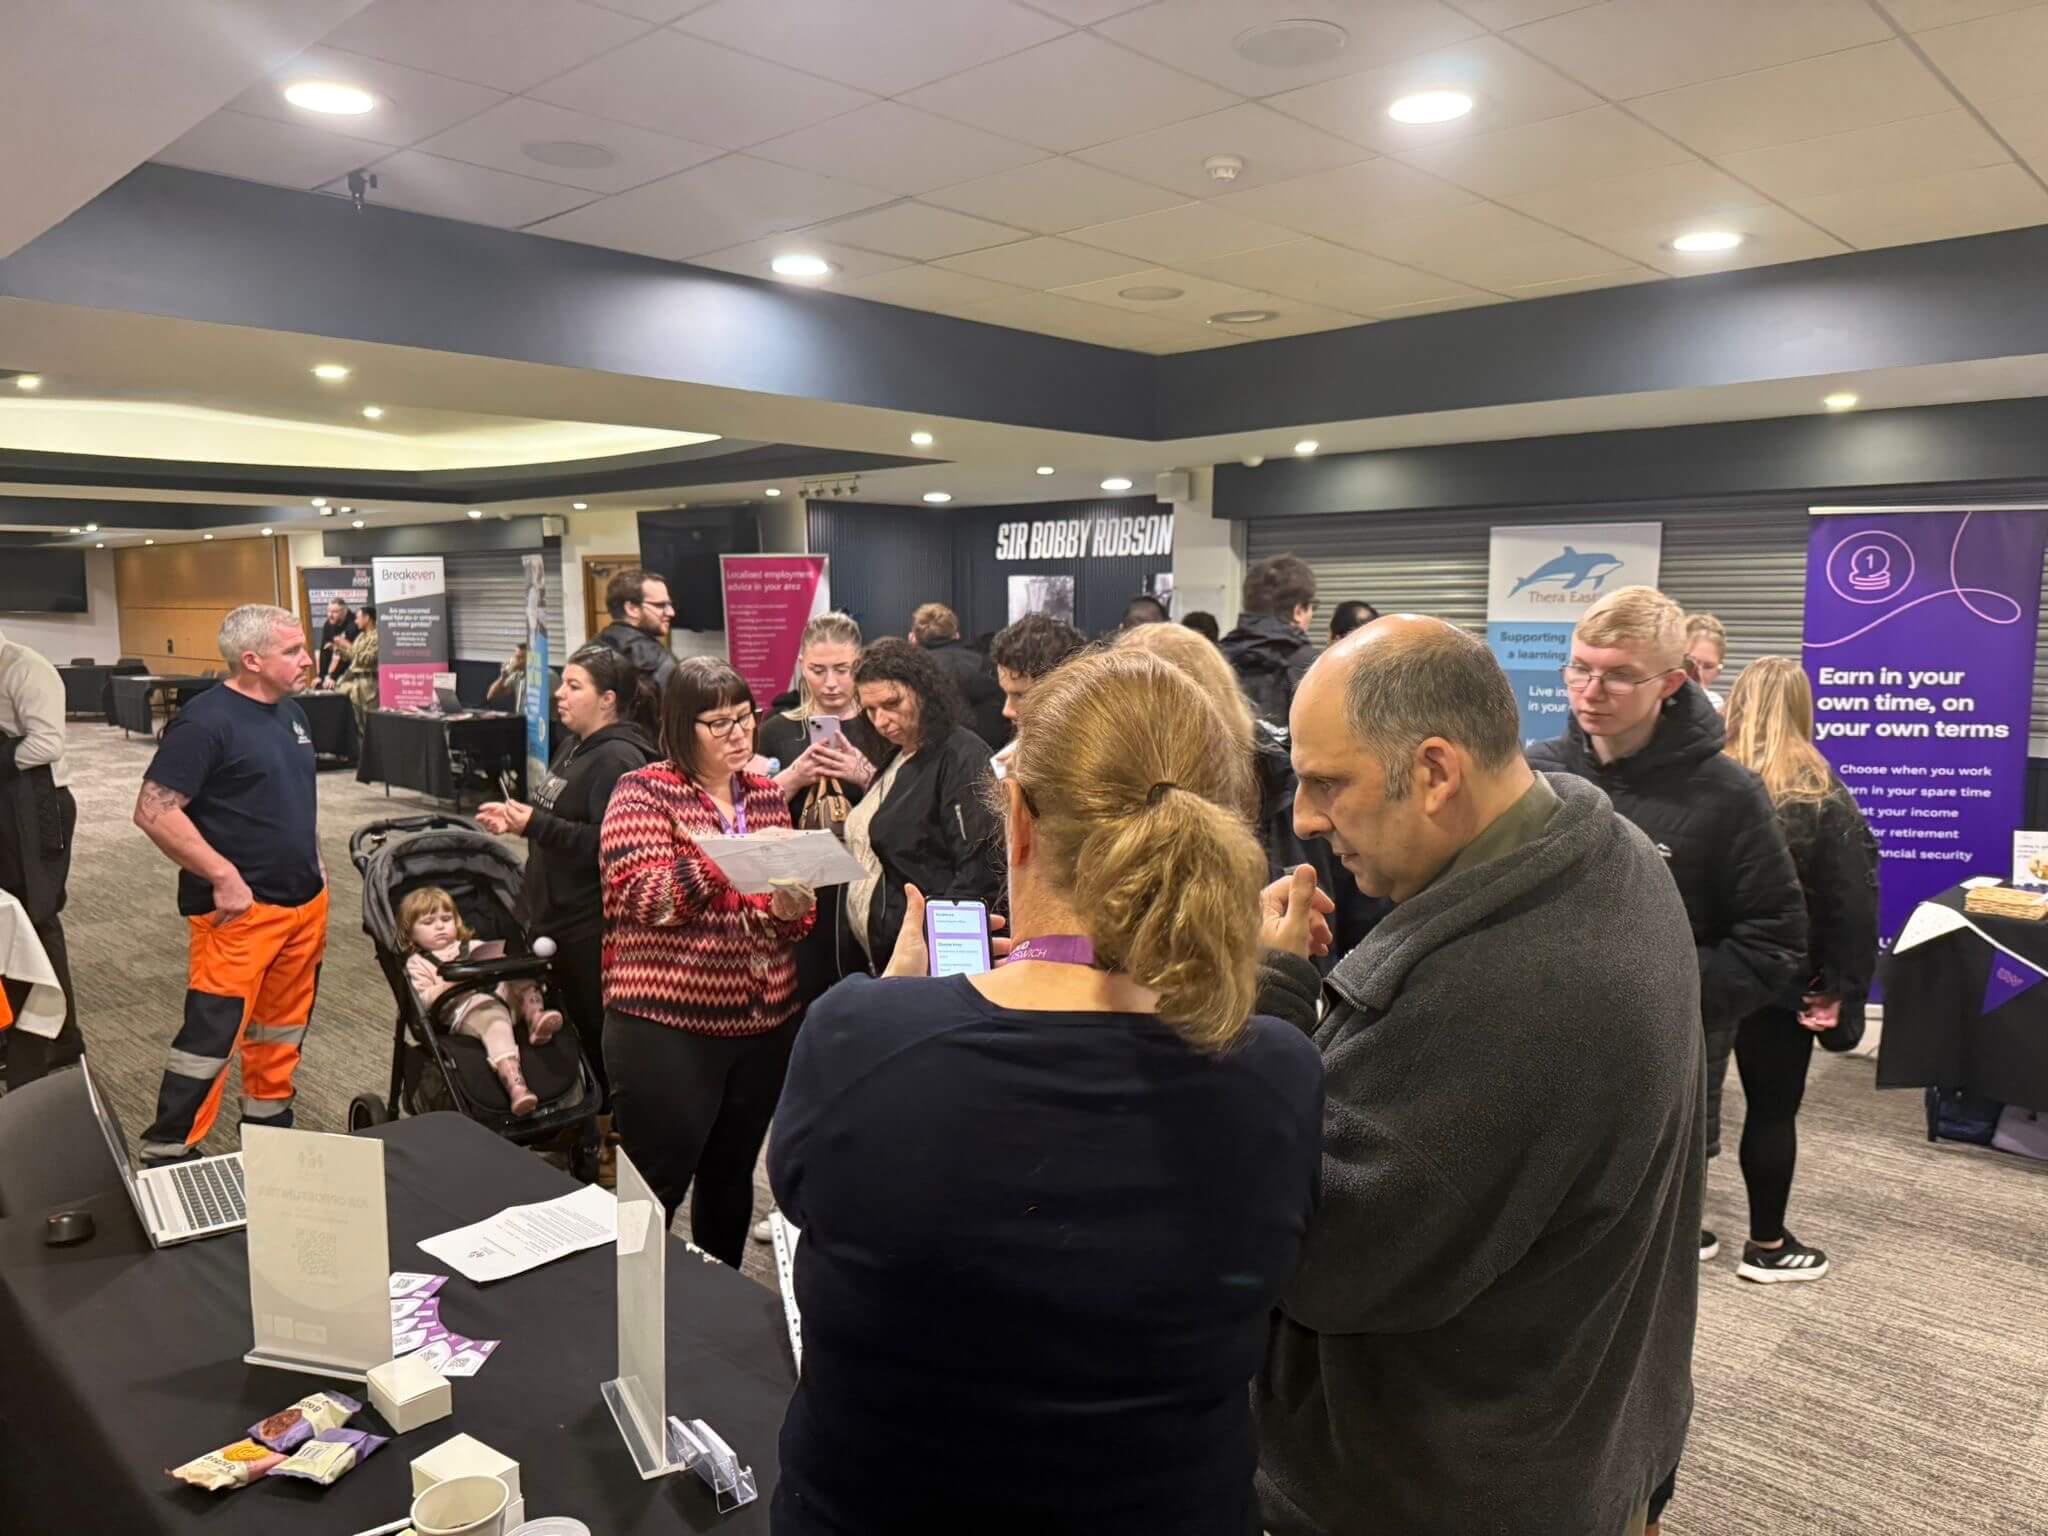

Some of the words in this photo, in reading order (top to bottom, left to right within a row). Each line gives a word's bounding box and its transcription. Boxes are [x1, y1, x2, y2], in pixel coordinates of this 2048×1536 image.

[995, 523, 1029, 560] SIR
[1029, 519, 1092, 559] BOBBY
[1092, 514, 1174, 557] ROBSON
[382, 568, 436, 581] Breakeven
[764, 570, 813, 581] employment
[727, 583, 752, 591] advice
[754, 583, 761, 591] in
[764, 583, 781, 593] your
[783, 583, 801, 591] area
[1528, 591, 1566, 603] Thera
[1500, 631, 1567, 645] Supporting
[1507, 651, 1514, 659] a
[1517, 649, 1567, 662] learning
[1818, 667, 1874, 686] Earn
[1879, 667, 1903, 686] in
[1908, 670, 1965, 690] your
[1529, 685, 1554, 697] Live
[1528, 702, 1538, 711] in
[1541, 704, 1567, 715] your
[1816, 696, 1870, 712] own
[1874, 693, 1937, 714] time,
[1941, 696, 1975, 712] on
[1815, 721, 1871, 741] your
[1875, 722, 1930, 738] own
[1935, 721, 2010, 739] terms
[1839, 764, 1888, 775] Choose
[1890, 765, 1927, 776] when
[1929, 767, 1955, 778] you
[1958, 766, 1993, 777] work
[1848, 785, 1868, 795] arn
[1871, 785, 1884, 795] in
[1886, 787, 1917, 798] your
[1920, 787, 1957, 799] spare
[1960, 787, 1992, 798] time
[1877, 808, 1907, 818] your
[1911, 807, 1960, 818] income
[1889, 828, 1960, 839] retirement
[1919, 850, 1973, 863] security
